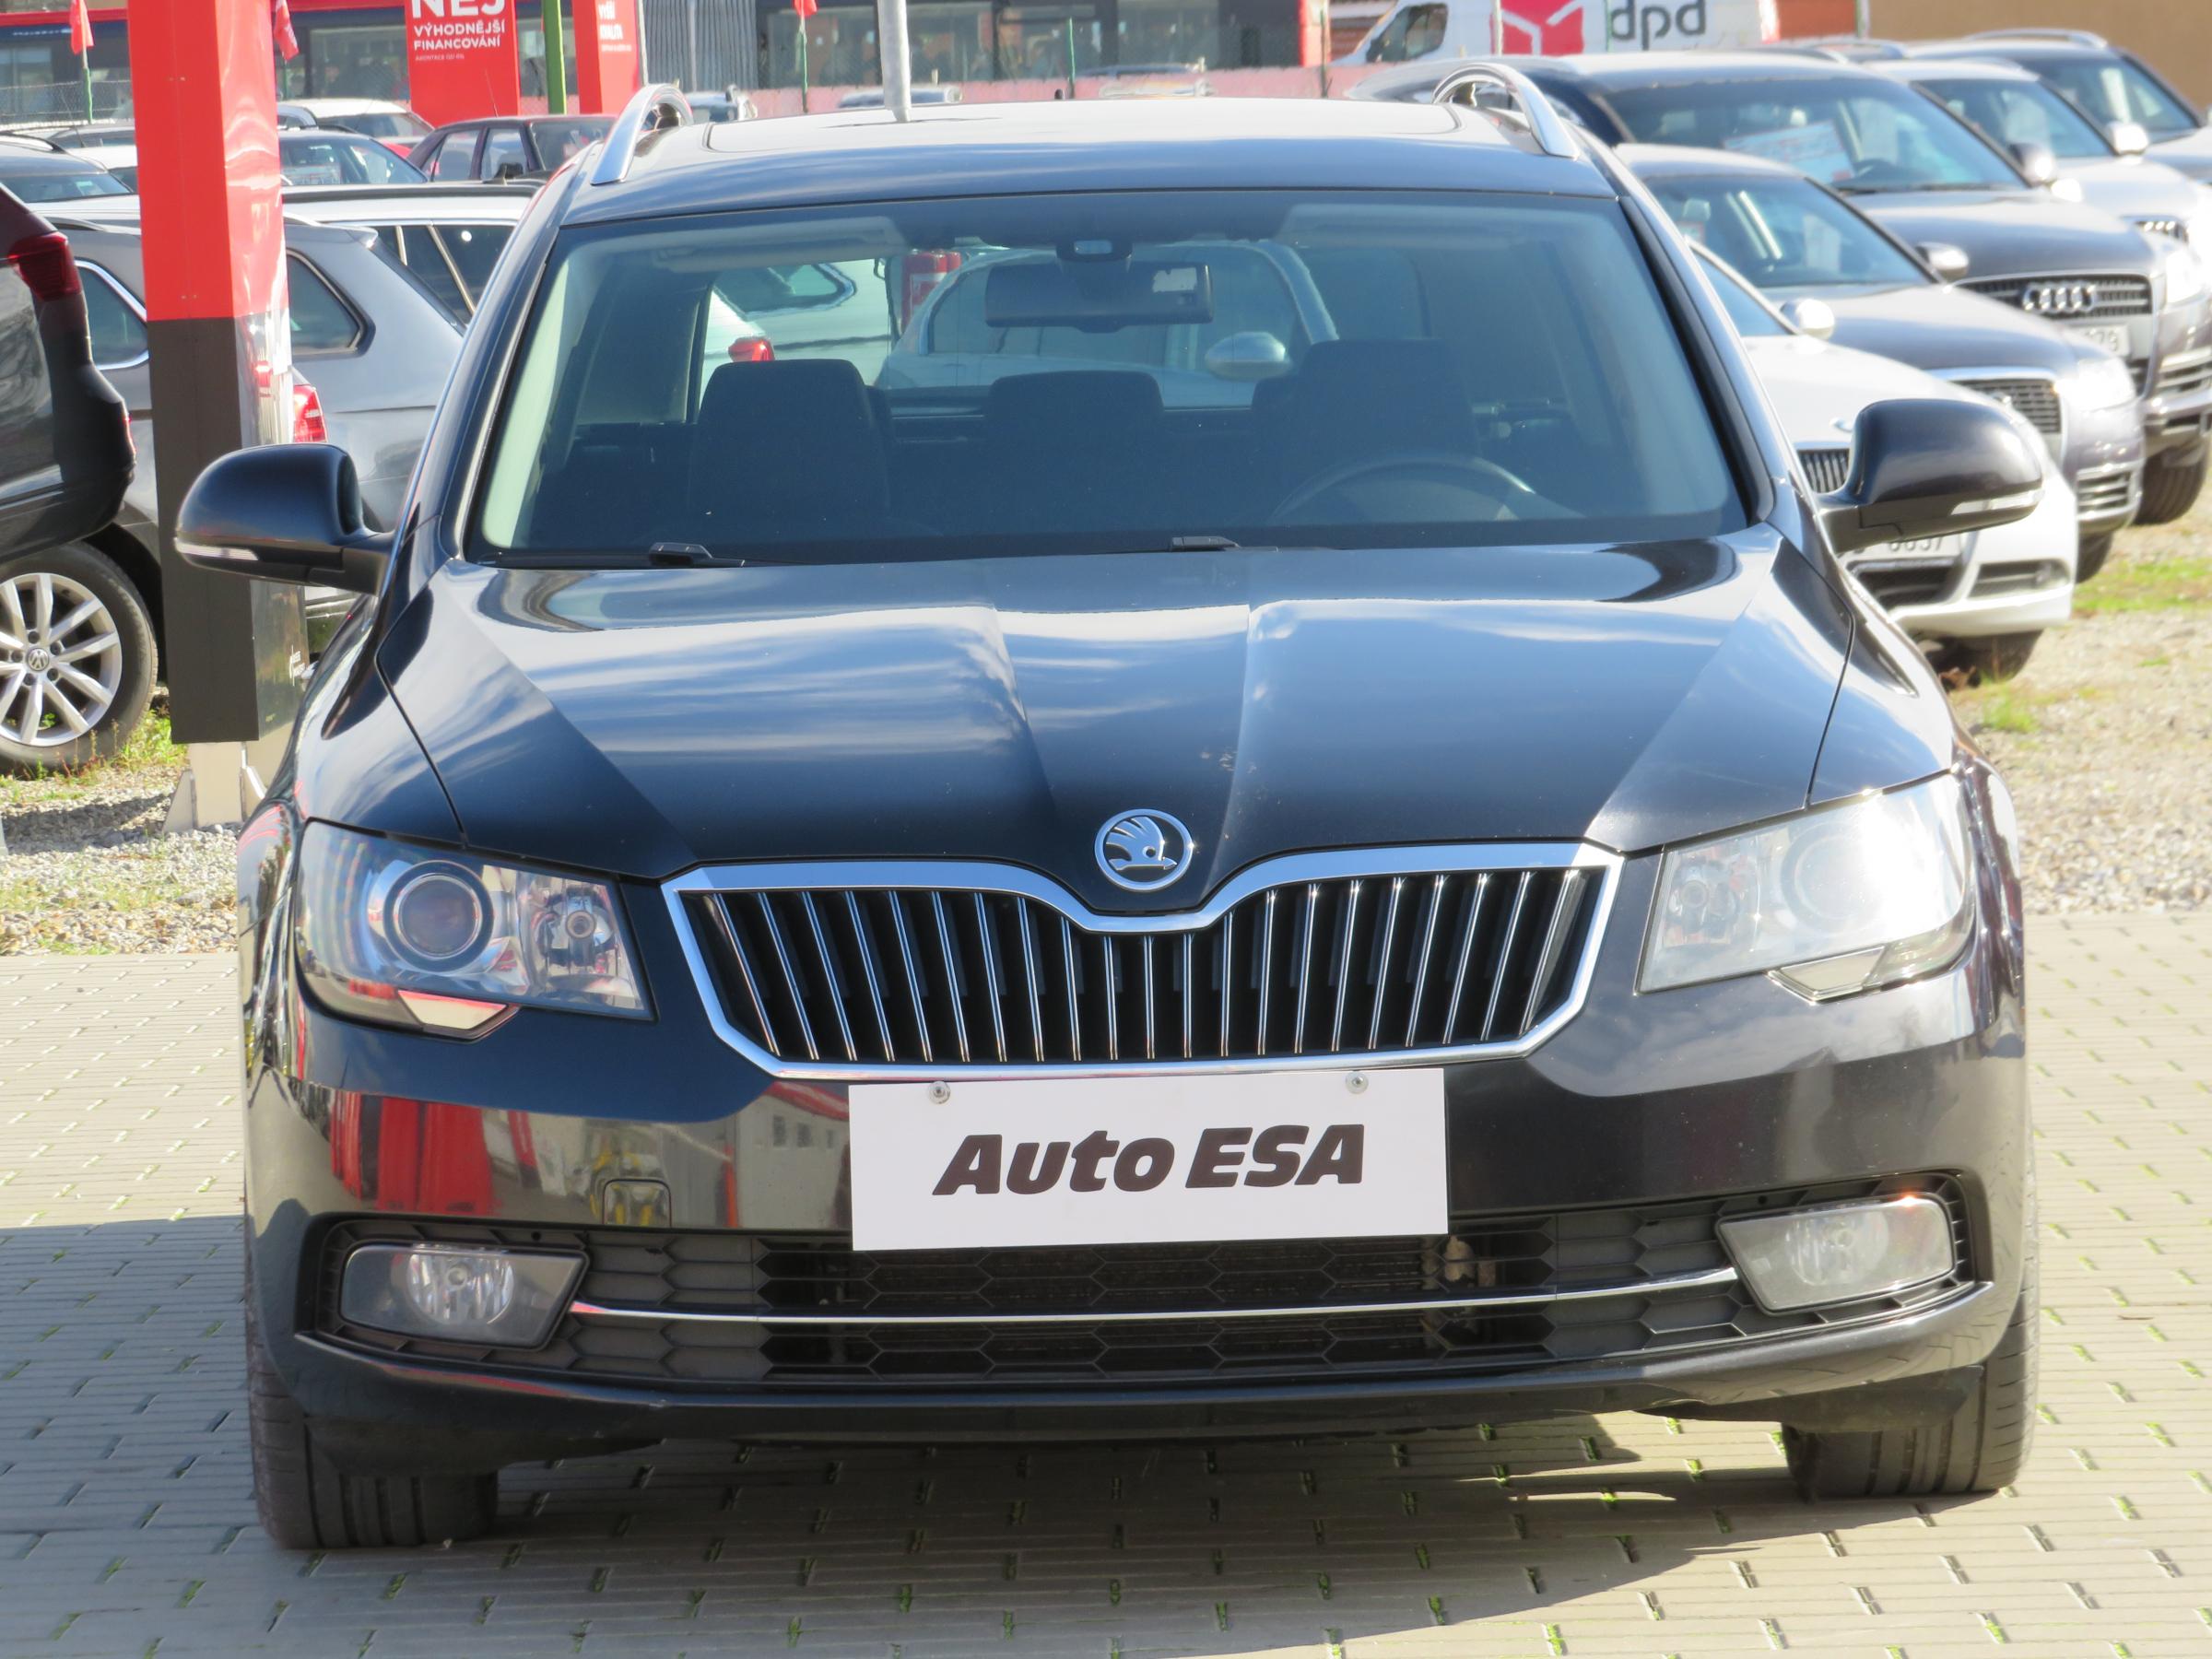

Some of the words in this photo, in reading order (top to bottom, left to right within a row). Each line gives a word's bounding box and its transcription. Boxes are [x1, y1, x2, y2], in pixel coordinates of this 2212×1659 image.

[414, 35, 501, 51] FINANCOVÁNÍ
[1610, 0, 1706, 51] dpd
[932, 1131, 1174, 1195] Auto
[1184, 1124, 1364, 1188] ESA
